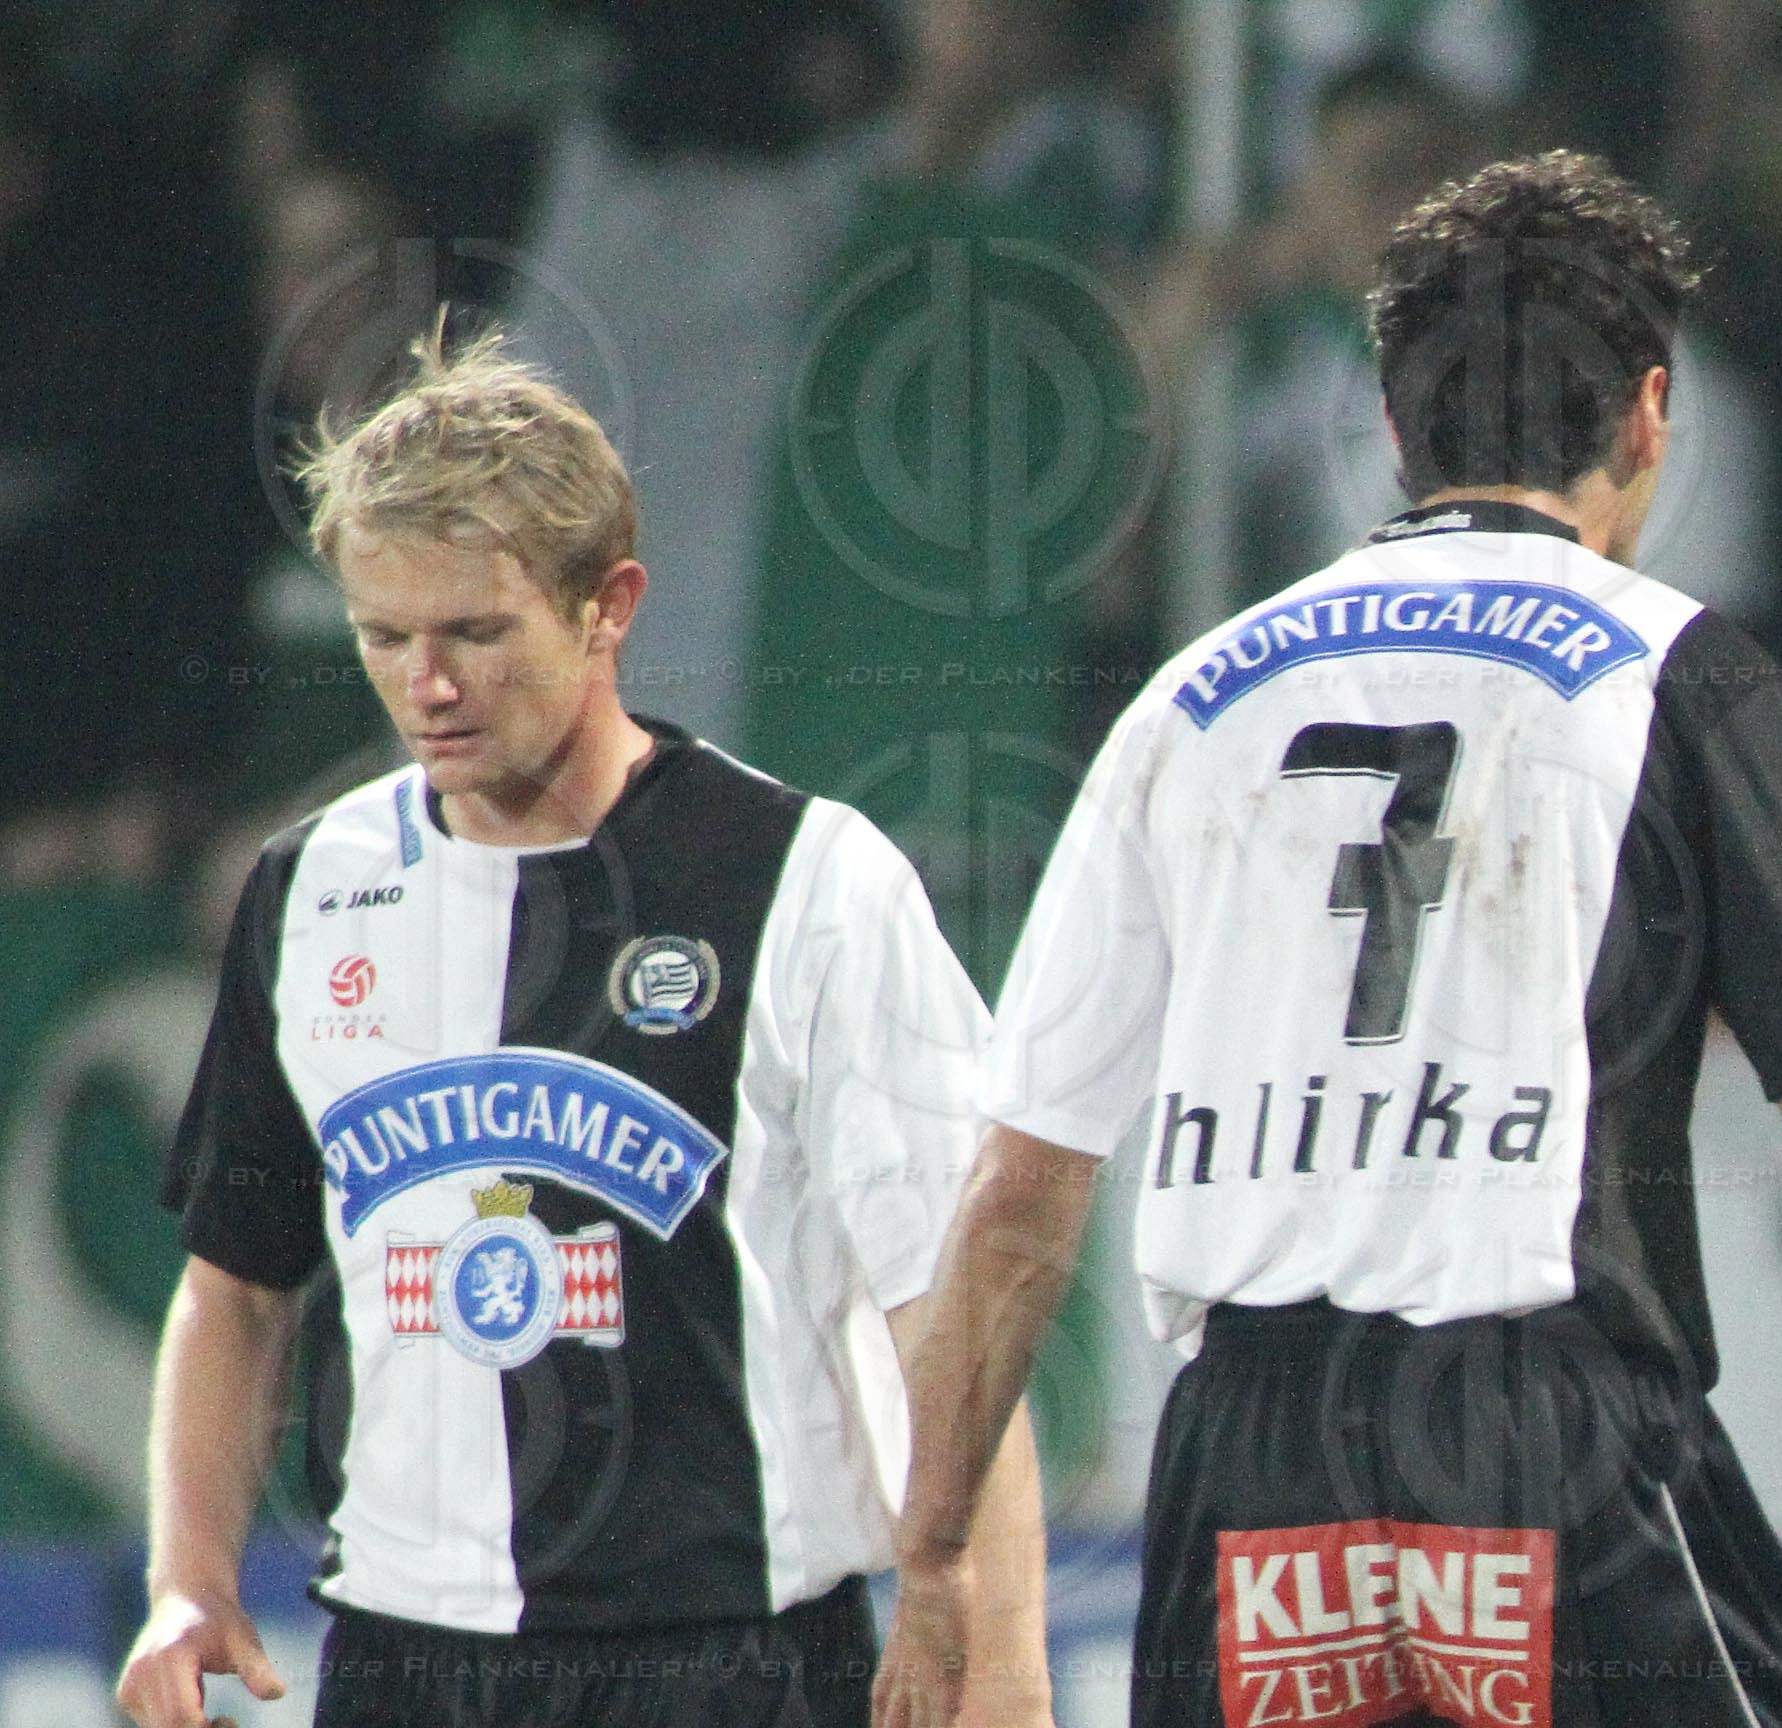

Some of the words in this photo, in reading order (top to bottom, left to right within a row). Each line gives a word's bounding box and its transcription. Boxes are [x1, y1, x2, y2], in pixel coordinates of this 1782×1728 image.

[1186, 590, 1612, 703] PUNTIGAMER
[346, 885, 404, 910] JAKO
[1280, 720, 1461, 1046] 7
[311, 1024, 385, 1041] LIGA
[322, 1080, 686, 1196] PUNTIGAMER
[1231, 1543, 1531, 1643] KLENE
[1239, 1651, 1536, 1728] ZEITNG
